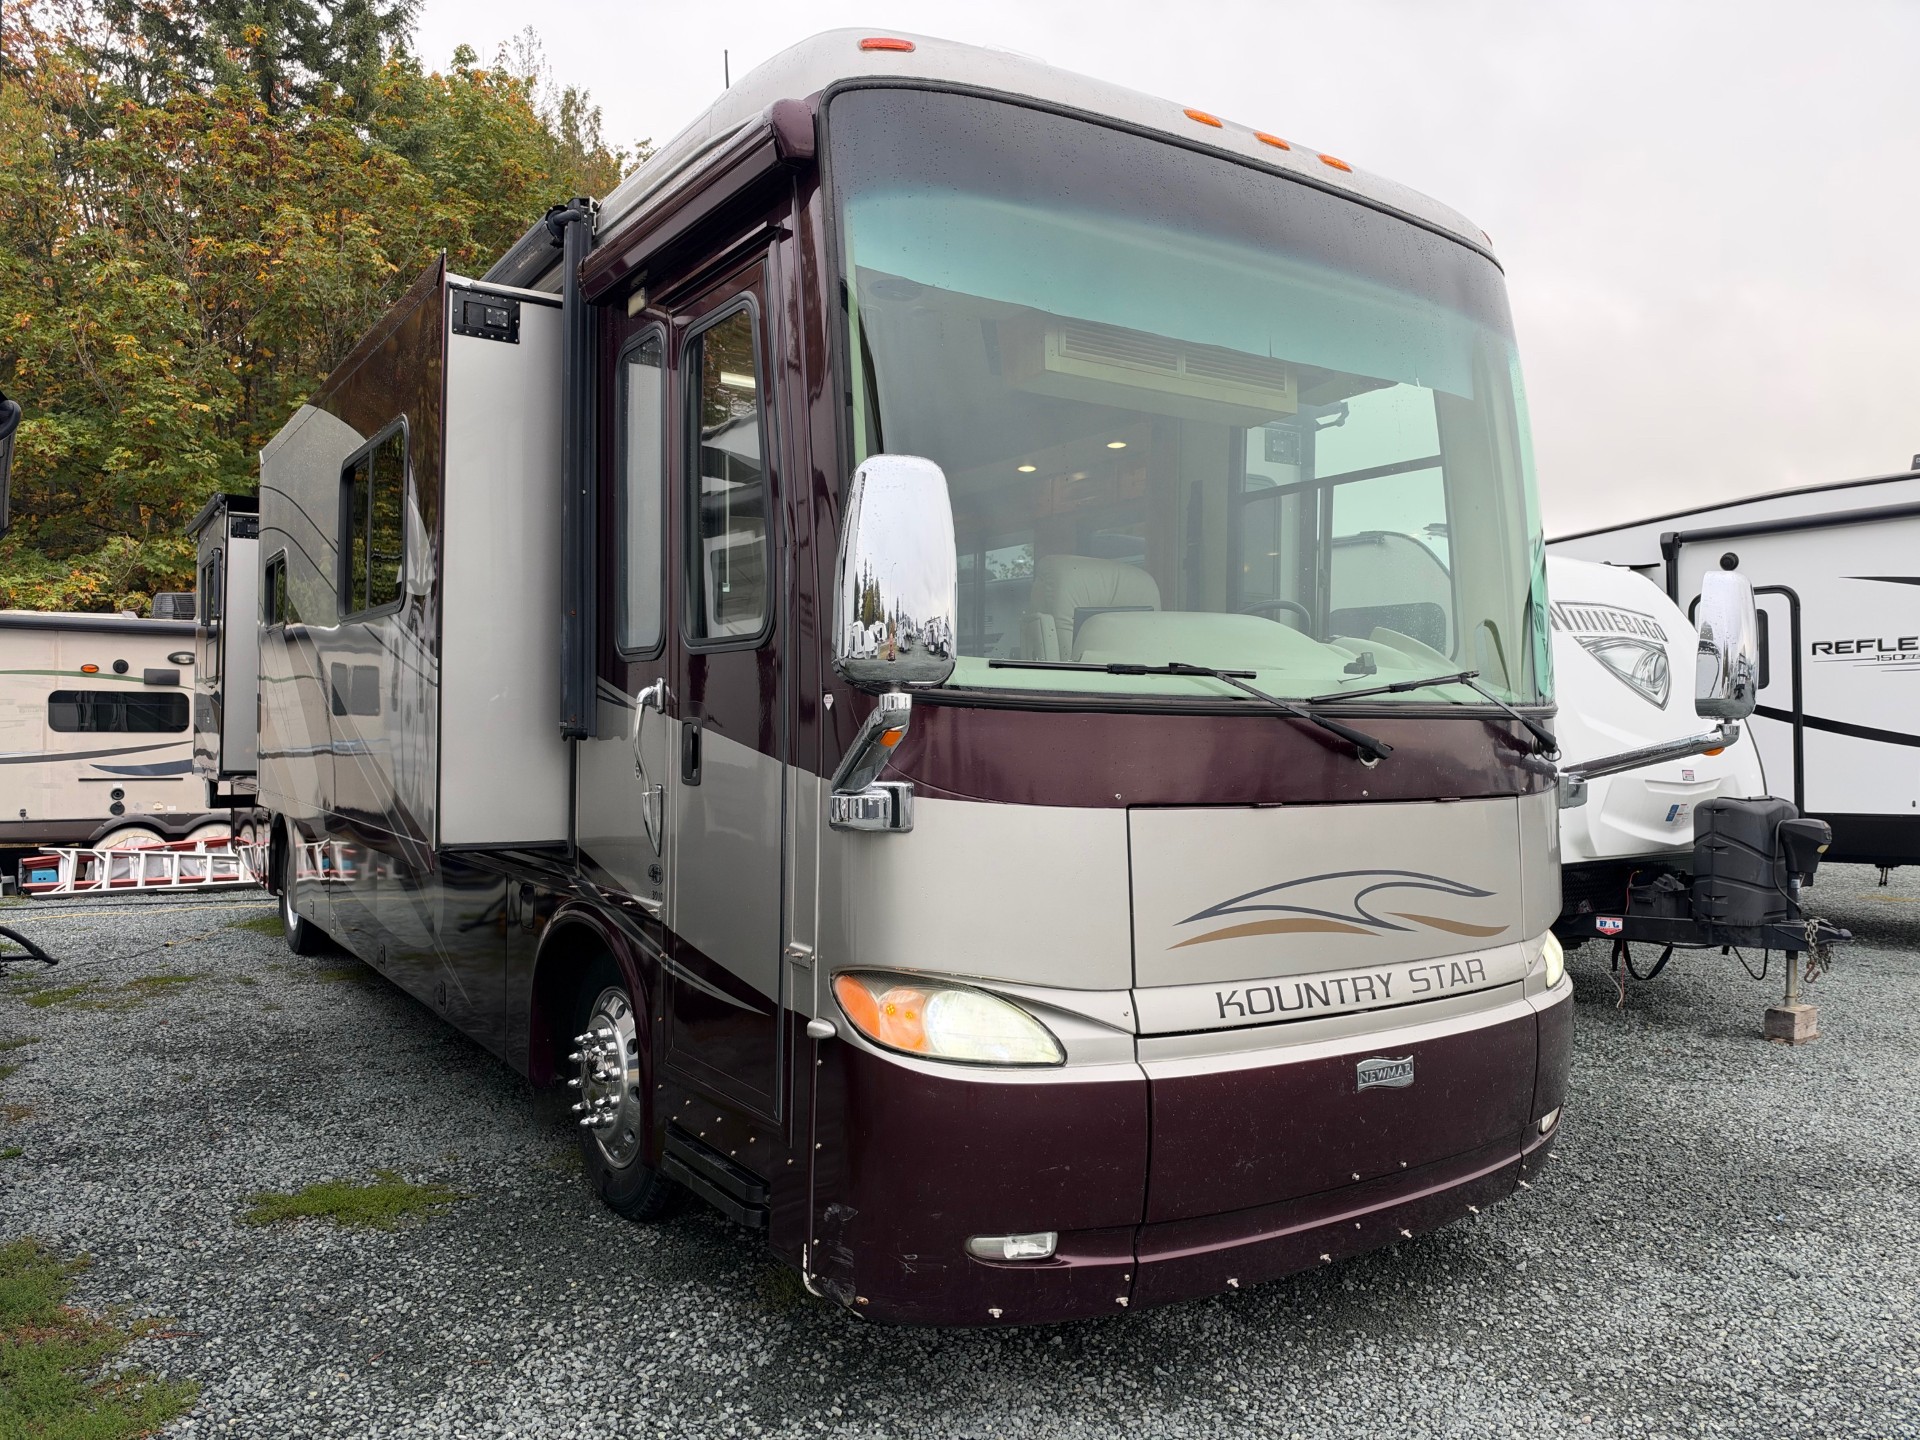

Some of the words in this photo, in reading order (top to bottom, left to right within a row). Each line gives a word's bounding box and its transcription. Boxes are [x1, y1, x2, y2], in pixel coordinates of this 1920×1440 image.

[1550, 601, 1668, 643] WINNEBAGO
[1811, 636, 1919, 656] REFLE
[1215, 972, 1392, 1019] KOUNTRY
[1408, 958, 1487, 994] STAR
[1359, 1063, 1413, 1084] NEWMAR
